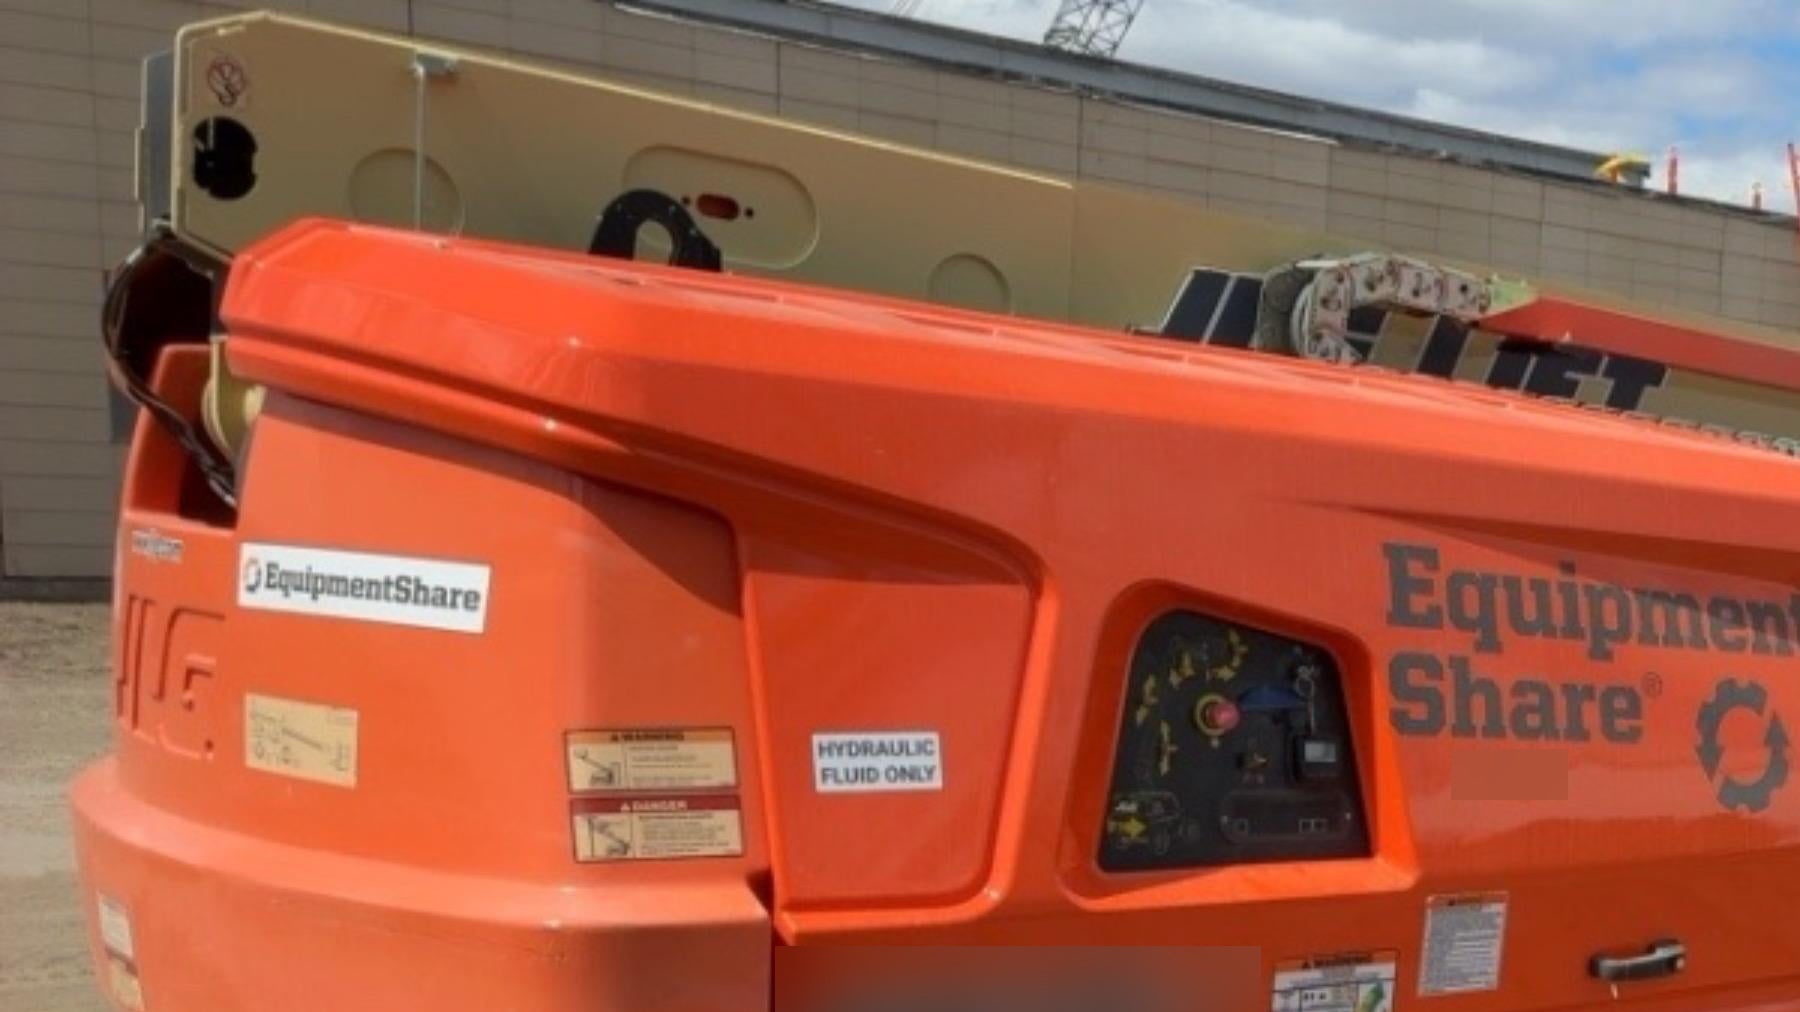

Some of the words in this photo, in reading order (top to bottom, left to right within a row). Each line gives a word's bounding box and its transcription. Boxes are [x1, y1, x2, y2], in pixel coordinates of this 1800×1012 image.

[264, 561, 482, 612] EquipmentShare
[818, 738, 935, 758] HYDRAULIC
[820, 765, 880, 785] FLUID
[884, 763, 936, 783] ONLY
